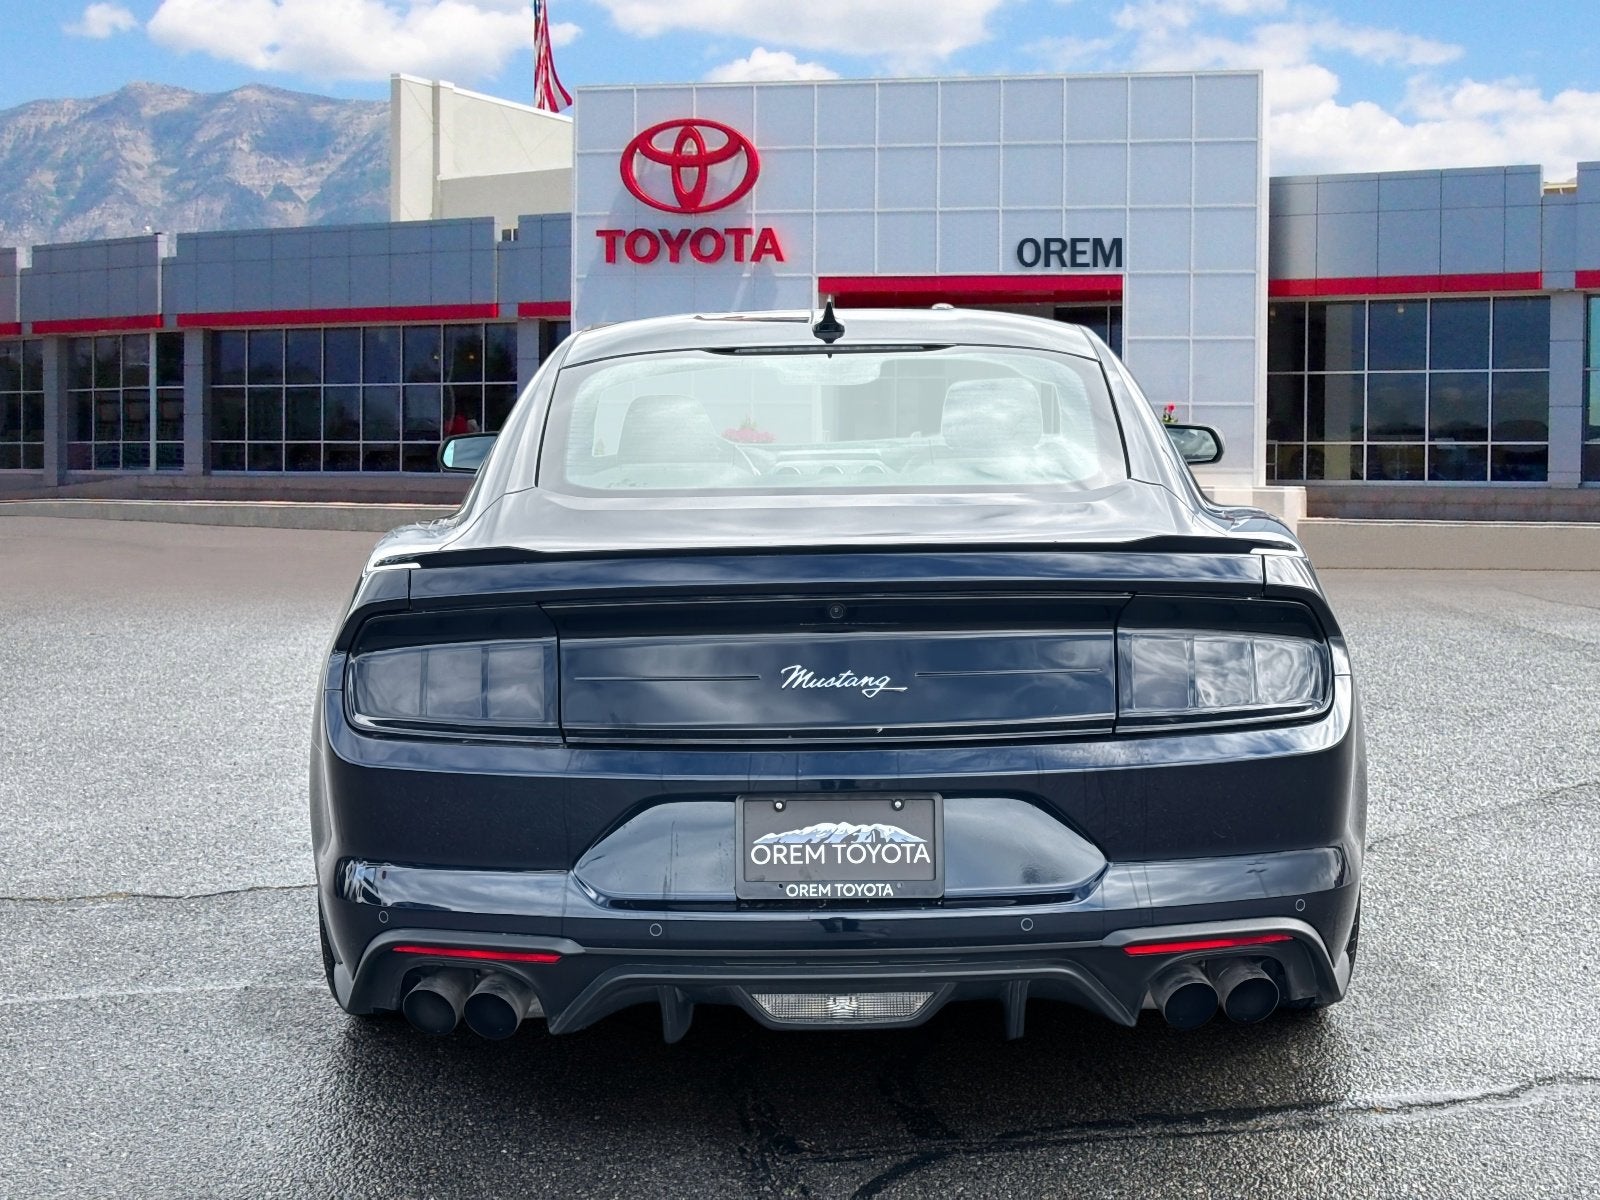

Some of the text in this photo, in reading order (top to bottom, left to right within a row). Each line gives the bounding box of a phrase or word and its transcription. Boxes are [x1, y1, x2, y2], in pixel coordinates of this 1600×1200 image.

[596, 227, 785, 264] TOYOTA
[1016, 237, 1123, 268] OREM
[781, 665, 908, 698] Mustang
[751, 843, 931, 865] OREM TOYOTA
[786, 884, 894, 897] OREM TOYOTA
